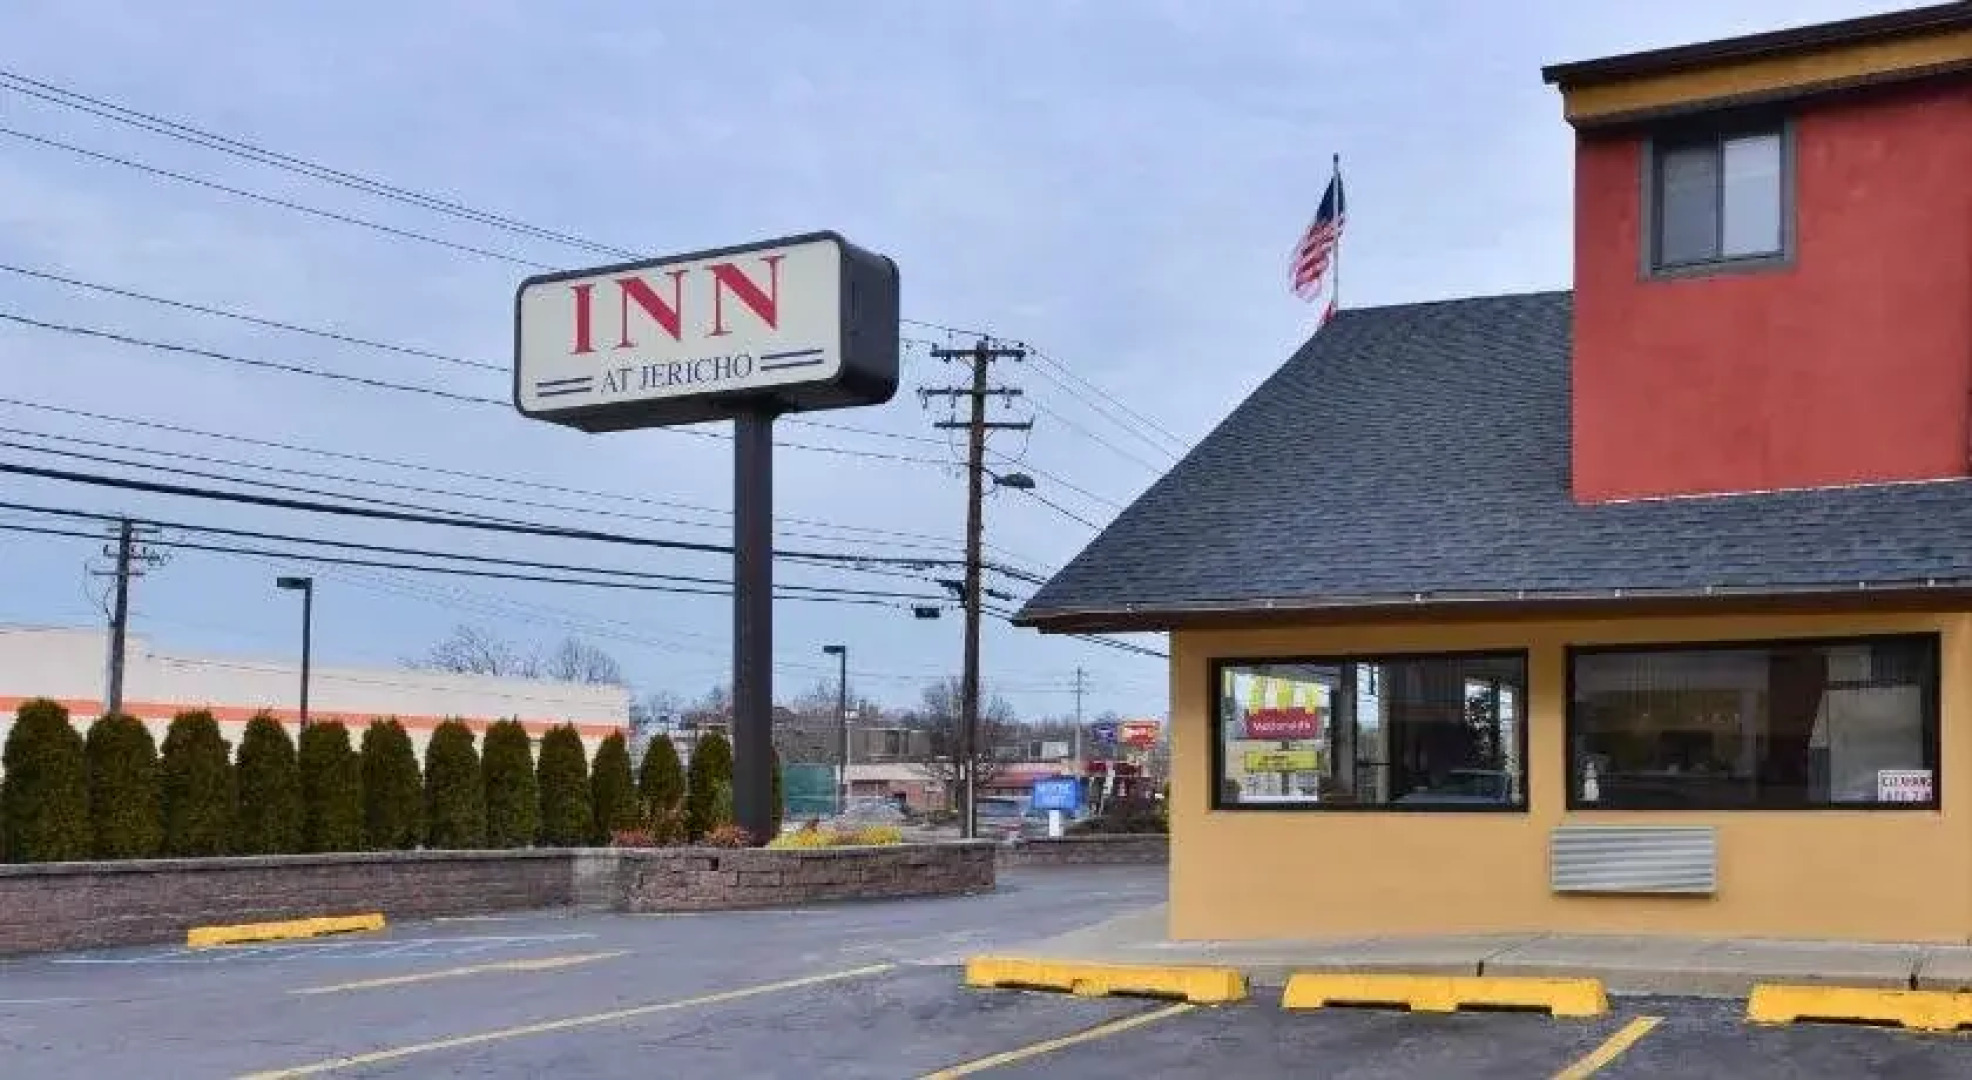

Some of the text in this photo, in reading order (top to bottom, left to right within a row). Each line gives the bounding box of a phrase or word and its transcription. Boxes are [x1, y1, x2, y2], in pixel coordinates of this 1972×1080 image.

[569, 255, 785, 355] INN
[600, 353, 753, 393] AT JERICHO
